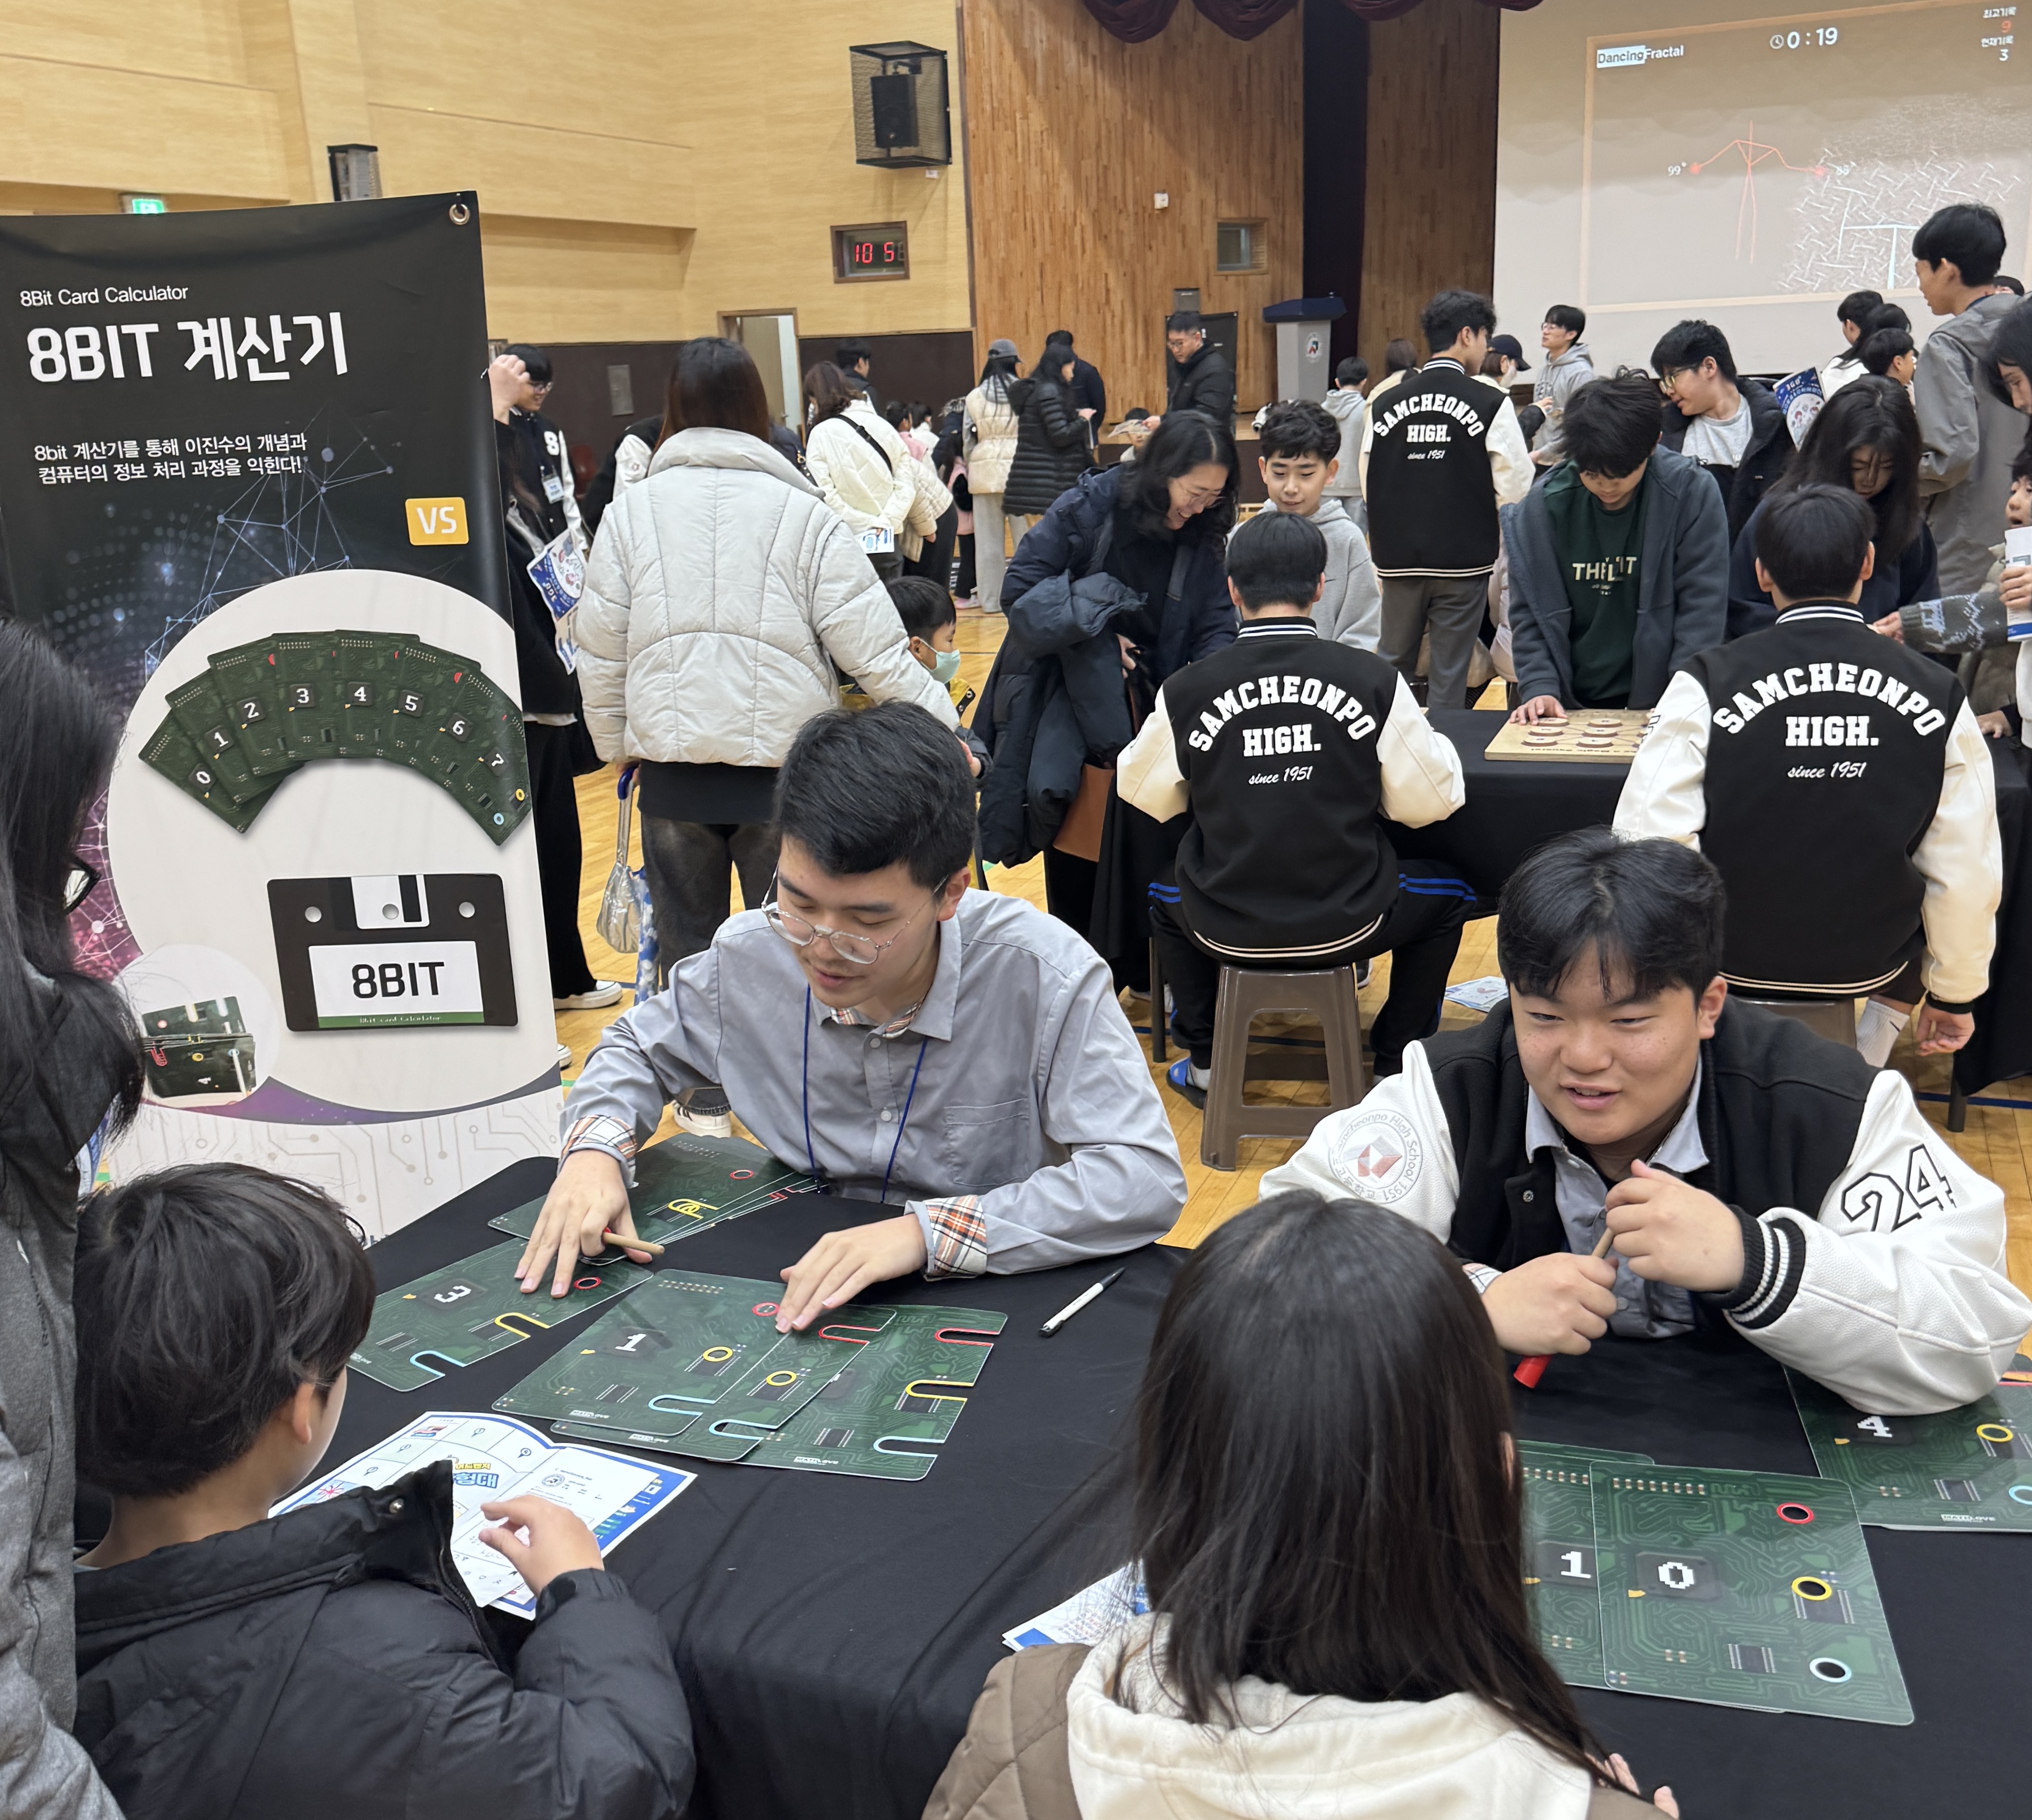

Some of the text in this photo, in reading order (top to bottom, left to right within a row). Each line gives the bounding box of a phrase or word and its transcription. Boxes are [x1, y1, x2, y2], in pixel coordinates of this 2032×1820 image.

[1999, 49, 2009, 61] 3
[20, 285, 189, 307] 8Bit Card Calculator
[27, 312, 347, 382] 8BIT 계산기
[1373, 393, 1484, 437] SAMCHEONPO
[1406, 424, 1451, 442] HIGH.
[34, 432, 308, 461] 8bit 계산기를 통해 이진수의 개념과
[1427, 449, 1446, 459] 1951
[38, 456, 303, 485] 컴퓨터의 정보 처리 과정을 익힌다!
[416, 506, 457, 535] VS
[296, 688, 310, 704] 3
[354, 686, 367, 702] 4
[405, 695, 418, 711] 5
[1712, 662, 1946, 736] SAMCHEONPO
[244, 702, 259, 719] 2
[1188, 675, 1376, 751] SAMCHEONPO
[452, 720, 466, 736] 6
[1786, 715, 1879, 746] HIGH.
[214, 732, 229, 747] 1
[1242, 724, 1321, 757] HIGH.
[491, 753, 504, 767] 7
[1787, 761, 1867, 778] since 1951
[196, 771, 211, 784] 0
[1248, 765, 1313, 785] since 1951
[351, 961, 445, 999] 8BIT
[1333, 1113, 1388, 1154] amcheonpo
[1403, 1139, 1420, 1182] School
[1840, 1143, 1956, 1233] 24
[434, 1285, 472, 1303] 3
[615, 1333, 647, 1352] 1
[1858, 1414, 1893, 1438] 4
[452, 1472, 499, 1489] 험대
[1560, 1551, 1591, 1579] 1
[1658, 1562, 1695, 1589] 0
